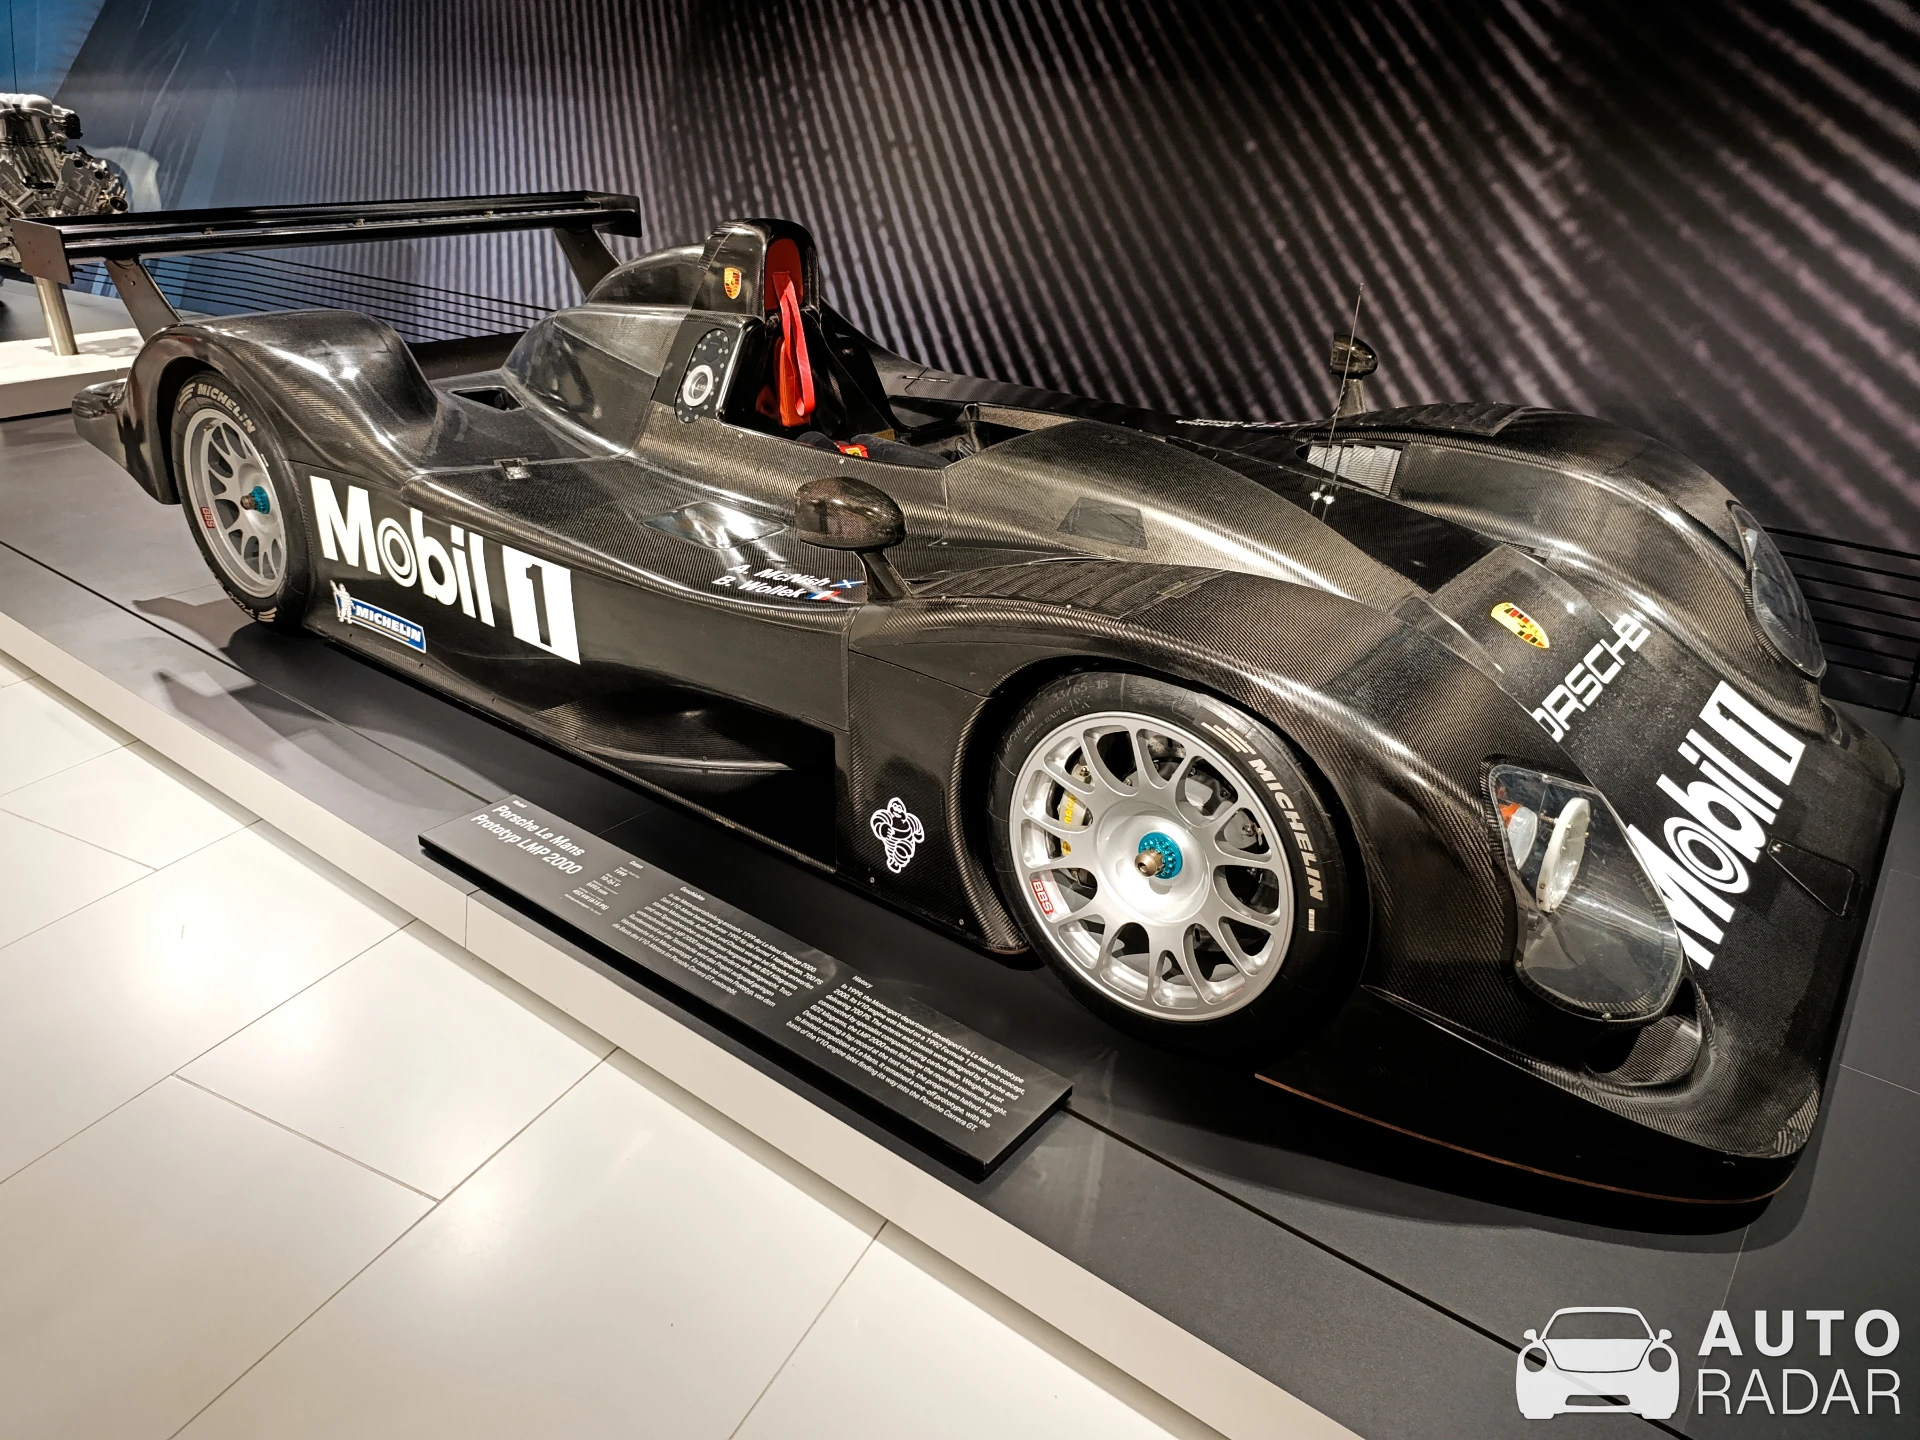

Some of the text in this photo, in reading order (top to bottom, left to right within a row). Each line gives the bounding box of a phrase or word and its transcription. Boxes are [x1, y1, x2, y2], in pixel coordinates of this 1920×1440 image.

[198, 384, 256, 433] MICHELIN
[310, 475, 495, 627] Mobil
[712, 575, 808, 598] B. Wollek
[727, 564, 831, 587] A. McNish
[356, 605, 423, 643] MICHELIN
[1004, 710, 1036, 755] MICHELIN
[470, 813, 583, 874] Prototyp LMP 2000
[491, 805, 585, 856] Porsche Le Mans
[1249, 758, 1323, 901] MICHELIN
[1627, 728, 1783, 970] Mobil
[1033, 881, 1053, 914] BBS
[852, 975, 873, 988] History
[786, 1020, 801, 1031] basis
[805, 1032, 816, 1040] the
[815, 1036, 829, 1046] V10
[826, 1044, 846, 1057] engine
[844, 1053, 859, 1064] later
[857, 1061, 878, 1076] finding
[876, 1072, 886, 1080] its
[885, 1077, 898, 1087] way
[896, 1083, 910, 1093] into
[908, 1090, 920, 1099] the
[919, 1095, 944, 1113] Porsche
[943, 1109, 966, 1126] Carrera
[800, 1018, 821, 1031] limited
[817, 1029, 850, 1049] competition
[883, 1065, 912, 1083] remained
[913, 1082, 937, 1097] one-off
[965, 1111, 979, 1122] with
[978, 1118, 990, 1128] the
[802, 1009, 823, 1024] Despite
[822, 1021, 842, 1035] setting
[844, 1033, 855, 1041] lap
[853, 1039, 874, 1051] record
[877, 1051, 889, 1060] the
[887, 1057, 901, 1067] test
[915, 1072, 927, 1081] the
[924, 1079, 948, 1093] project
[947, 1090, 960, 1100] was
[959, 1096, 981, 1111] halted
[979, 1108, 992, 1118] due
[810, 1004, 824, 1013] 822
[847, 1024, 857, 1032] the
[856, 1029, 871, 1038] LMP
[868, 1036, 886, 1048] 2000
[883, 1045, 898, 1055] even
[896, 1052, 908, 1060] fell
[905, 1056, 924, 1069] below
[923, 1066, 934, 1075] the
[932, 1072, 959, 1088] required
[956, 1085, 985, 1104] minimum
[817, 999, 851, 1019] constructed
[855, 1020, 882, 1036] specialist
[880, 1034, 912, 1052] companies
[910, 1050, 927, 1062] using
[926, 1058, 947, 1072] carbon
[962, 1076, 990, 1096] Weighing
[989, 1093, 1004, 1103] just
[825, 994, 851, 1011] delivering
[850, 1006, 864, 1016] 700
[871, 1017, 882, 1026] The
[880, 1024, 903, 1037] exterior
[901, 1035, 914, 1043] and
[912, 1041, 934, 1054] chassis
[933, 1052, 948, 1062] were
[946, 1059, 975, 1077] designed
[980, 1077, 1006, 1094] Porsche
[1004, 1091, 1019, 1100] and
[849, 996, 857, 1004] Its
[856, 1000, 870, 1009] V10
[867, 1007, 886, 1019] engine
[885, 1017, 897, 1025] was
[896, 1022, 915, 1034] based
[925, 1037, 942, 1049] 1992
[940, 1045, 965, 1061] Formula
[967, 1061, 988, 1073] power
[986, 1071, 1000, 1080] unit
[870, 999, 902, 1018] Motorsport
[900, 1015, 933, 1035] department
[931, 1032, 962, 1050] developed
[960, 1046, 971, 1055] the
[977, 1055, 995, 1068] Mans
[993, 1064, 1024, 1083] Prototype
